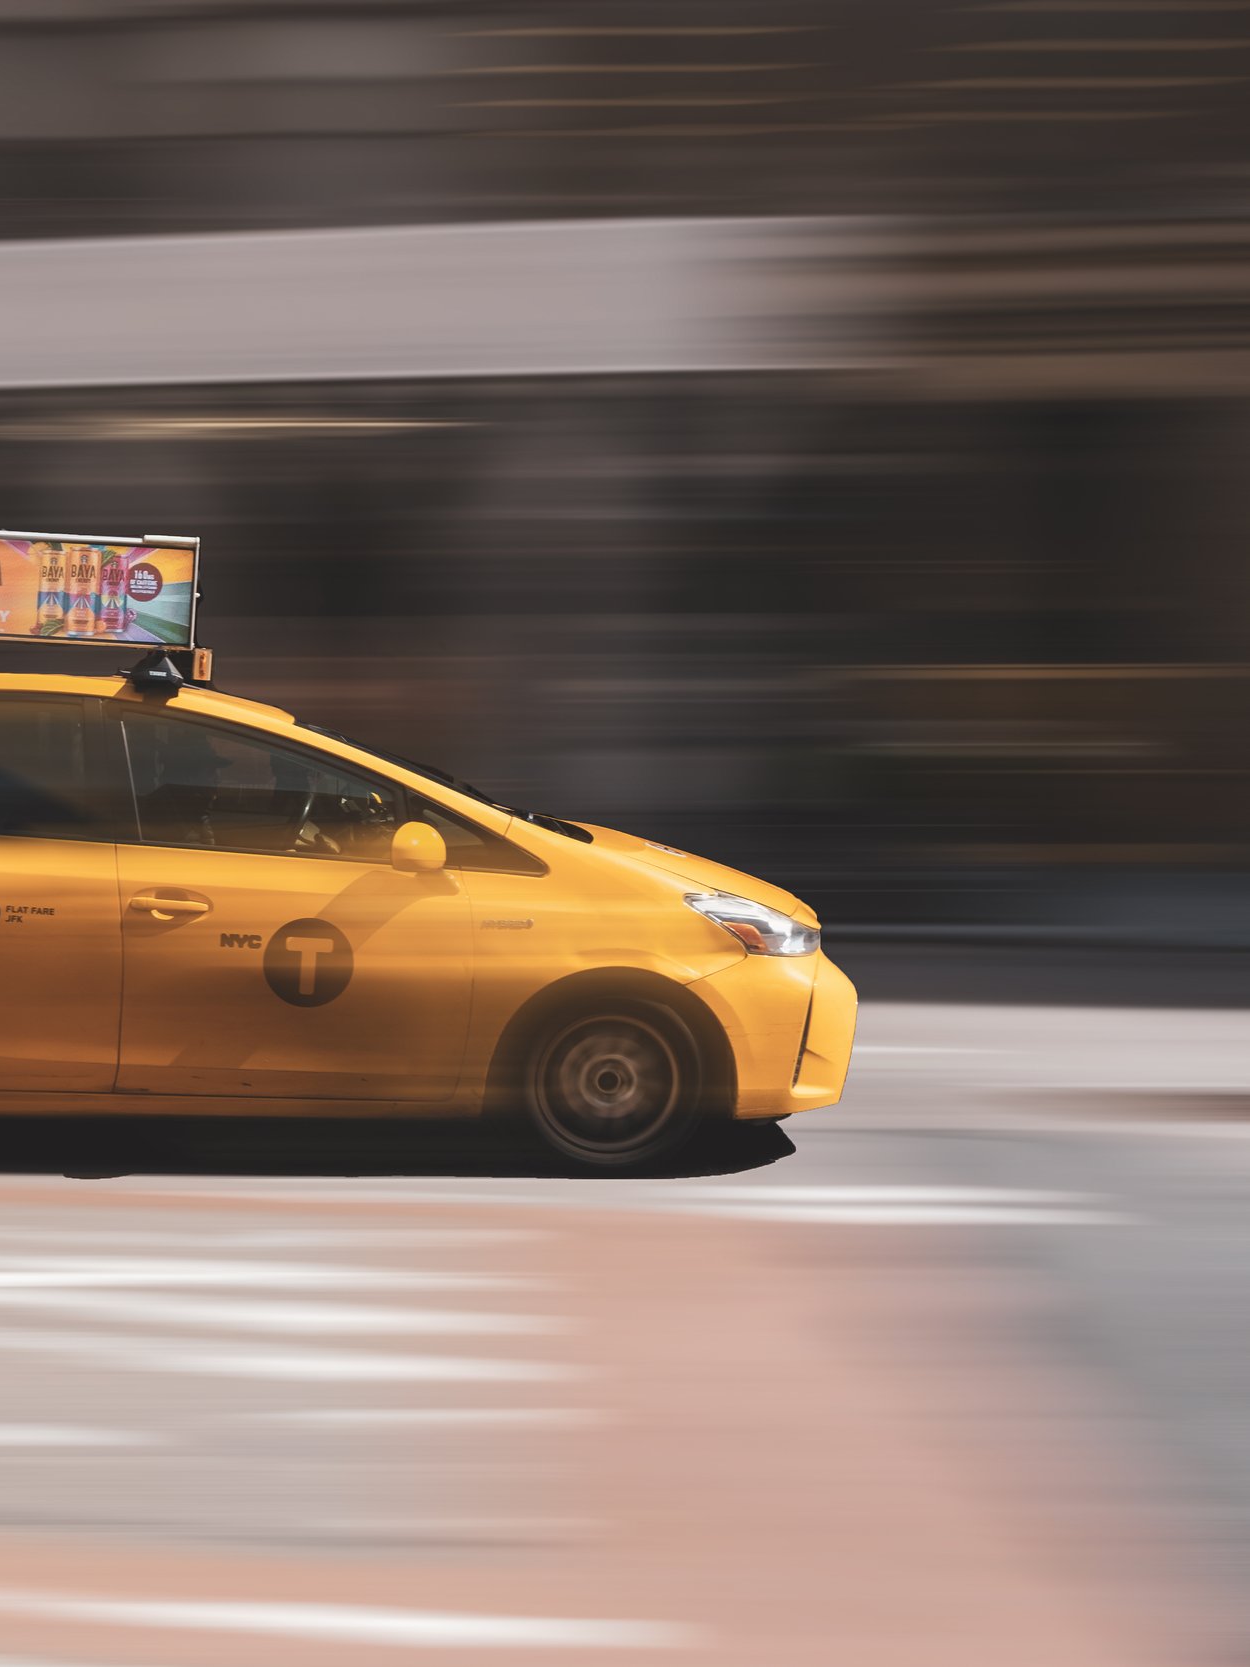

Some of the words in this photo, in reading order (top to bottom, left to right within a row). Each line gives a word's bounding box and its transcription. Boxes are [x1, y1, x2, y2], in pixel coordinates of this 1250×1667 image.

[41, 566, 65, 578] BAYA
[71, 564, 96, 579] BAYA
[5, 905, 28, 914] FLAT
[31, 907, 55, 916] FARE
[5, 915, 23, 923] JFK
[220, 933, 263, 949] NYC
[286, 936, 334, 995] T
